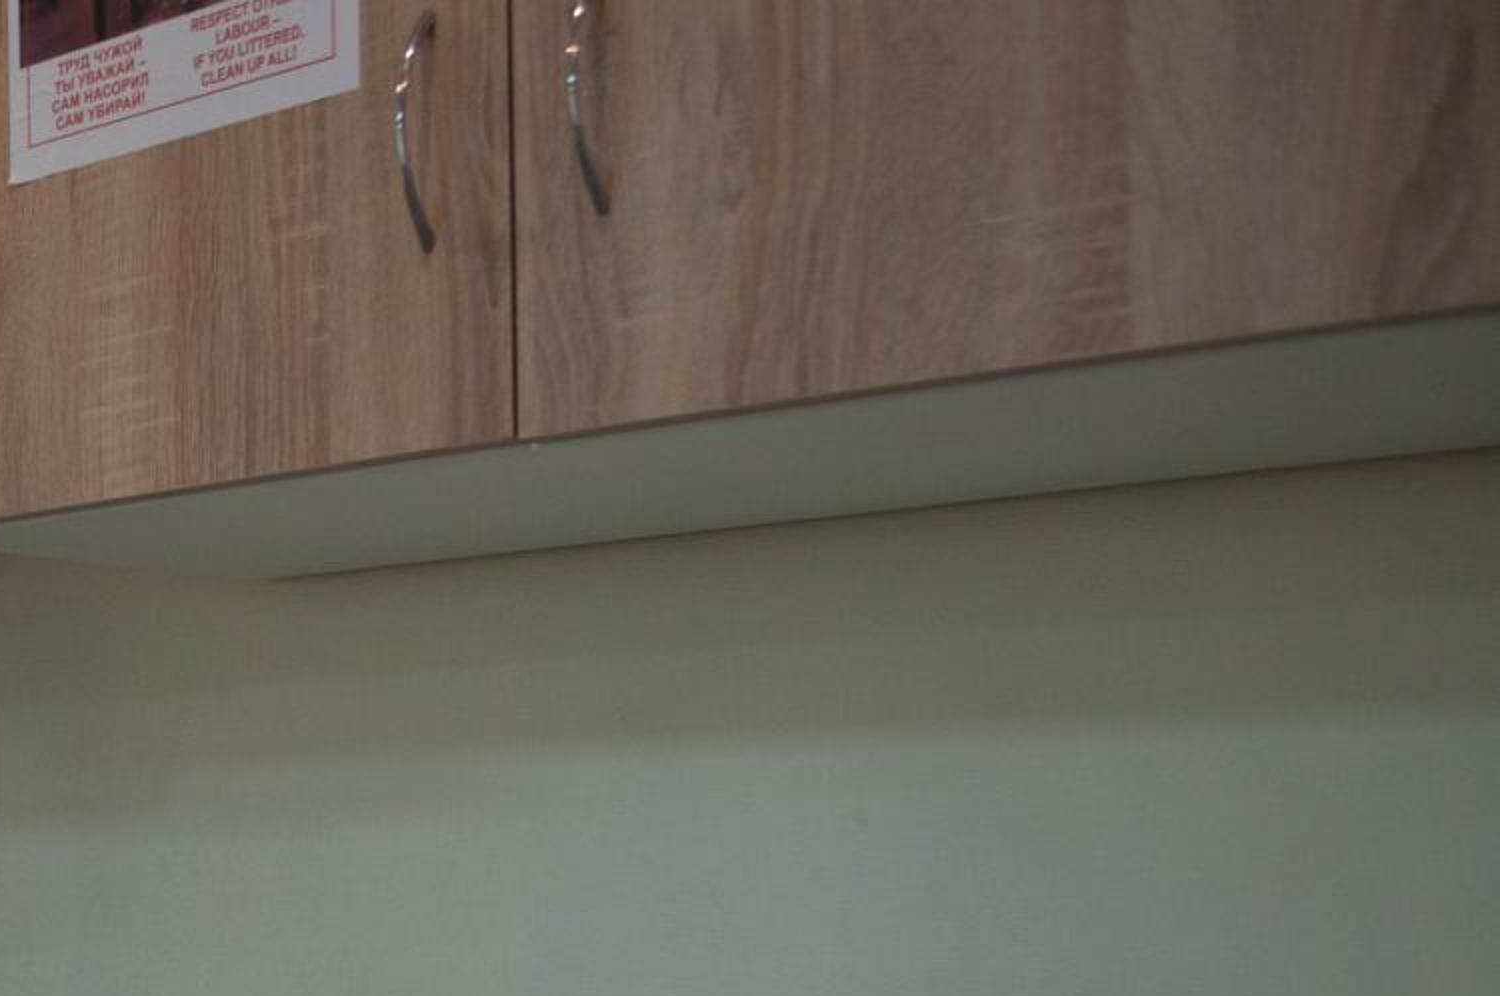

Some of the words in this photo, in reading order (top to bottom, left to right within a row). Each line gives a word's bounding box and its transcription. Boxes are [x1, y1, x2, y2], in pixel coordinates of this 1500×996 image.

[215, 15, 270, 44] LABOUR
[57, 53, 90, 76] ТРУД
[93, 34, 142, 62] ЧУЖОЙ
[208, 43, 236, 64] YOU
[201, 60, 245, 87] CLEAN
[247, 54, 266, 73] UP
[52, 92, 81, 114] САМ
[83, 71, 150, 104] НАСОРИЛ
[54, 77, 76, 95] ТЫ
[55, 111, 85, 131] САМ
